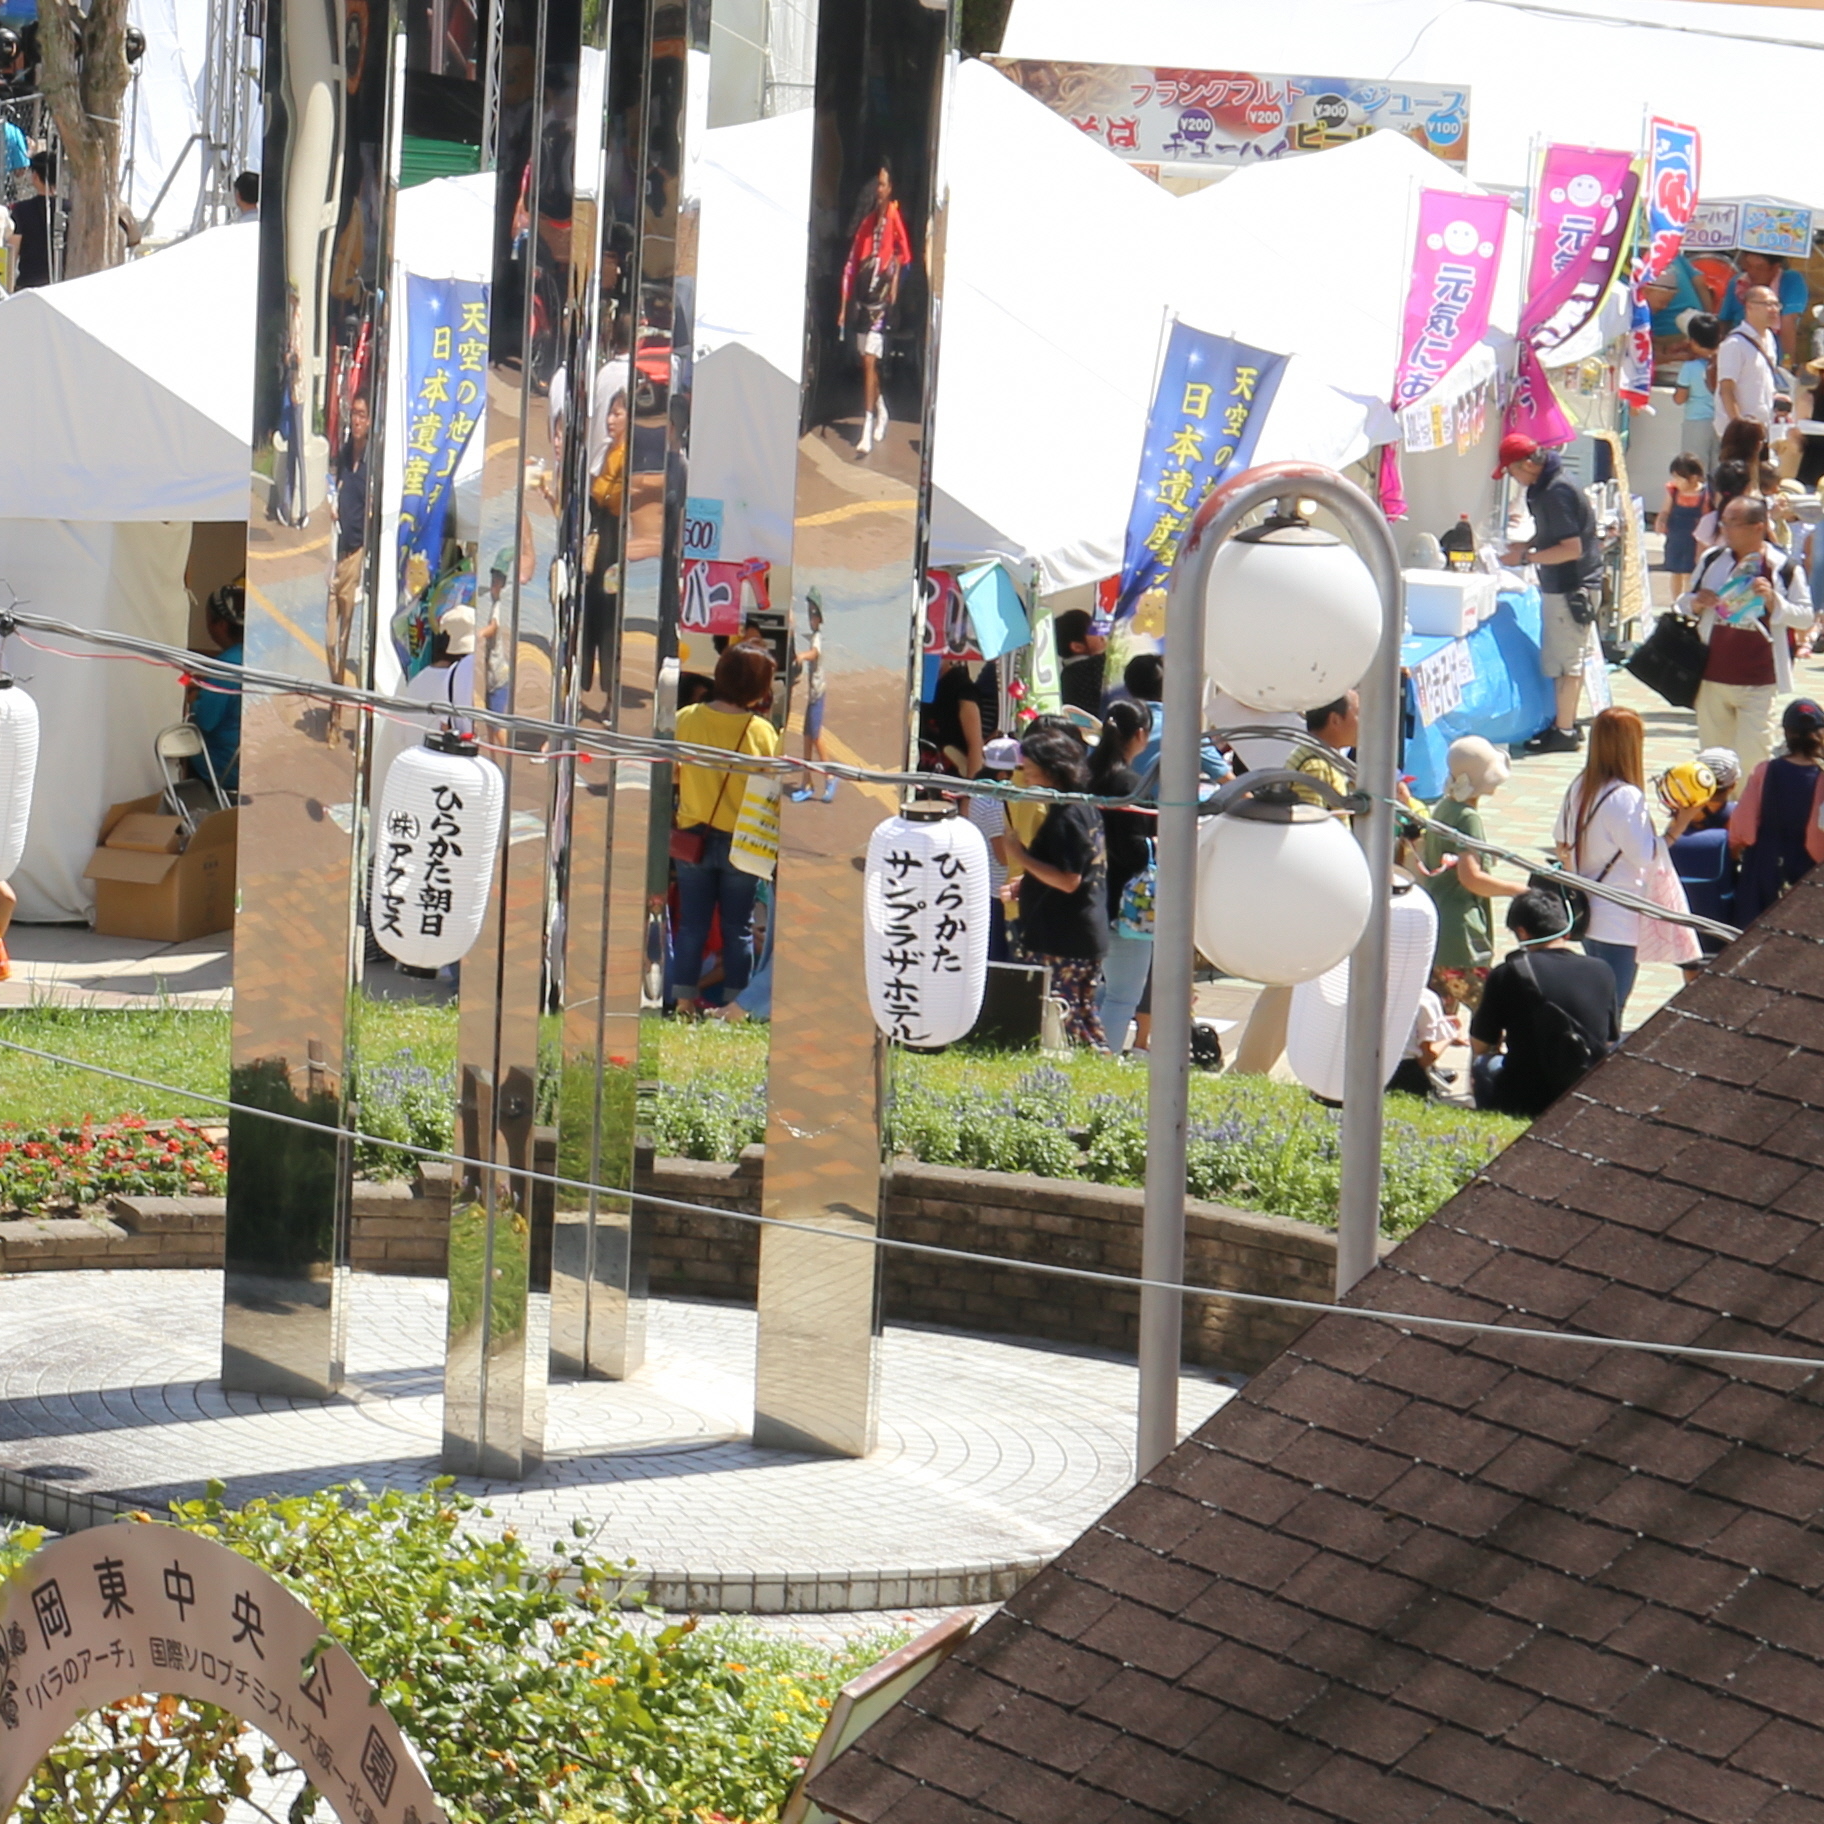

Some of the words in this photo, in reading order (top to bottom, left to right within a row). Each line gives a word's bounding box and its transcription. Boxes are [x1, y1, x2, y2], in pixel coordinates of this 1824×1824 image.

[1129, 79, 1306, 109] フランクフルト
[1358, 85, 1468, 118] ジュース
[1179, 117, 1212, 133] ¥200
[1250, 110, 1281, 125] ¥200
[1314, 103, 1347, 120] ¥300
[1428, 119, 1458, 135] ¥100
[1163, 132, 1290, 159] チューハイ
[1745, 210, 1809, 229] ジュース
[378, 809, 420, 938] (株)アクセス
[415, 785, 465, 938] ひらかた朝日
[932, 853, 969, 973] ひらかた
[881, 851, 933, 1042] サンプラザホテル
[25, 1638, 136, 1710] 「バラのアーチ」
[31, 1556, 399, 1808] 岡東中央公園
